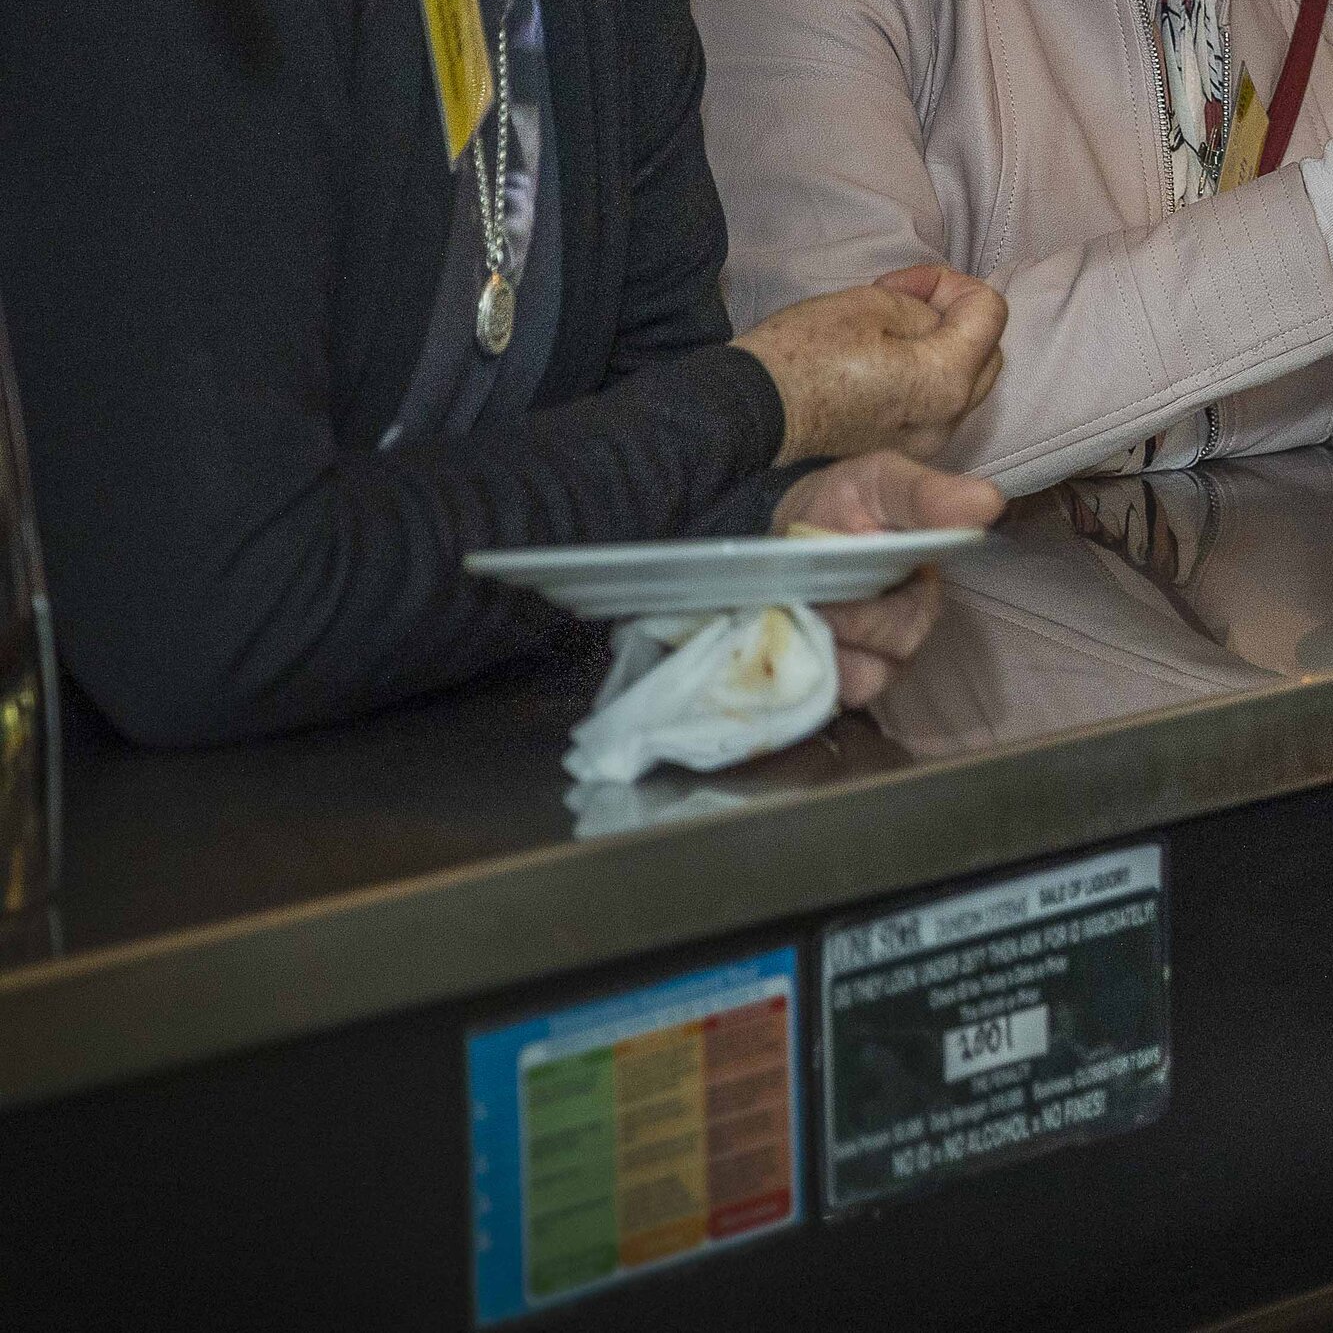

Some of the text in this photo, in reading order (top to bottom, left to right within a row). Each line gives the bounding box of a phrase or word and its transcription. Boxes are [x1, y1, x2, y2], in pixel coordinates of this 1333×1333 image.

[892, 1145, 913, 1179] NO
[943, 1130, 964, 1162] NO
[968, 1111, 1029, 1154] ALCOHOL
[1041, 1100, 1062, 1133] NO
